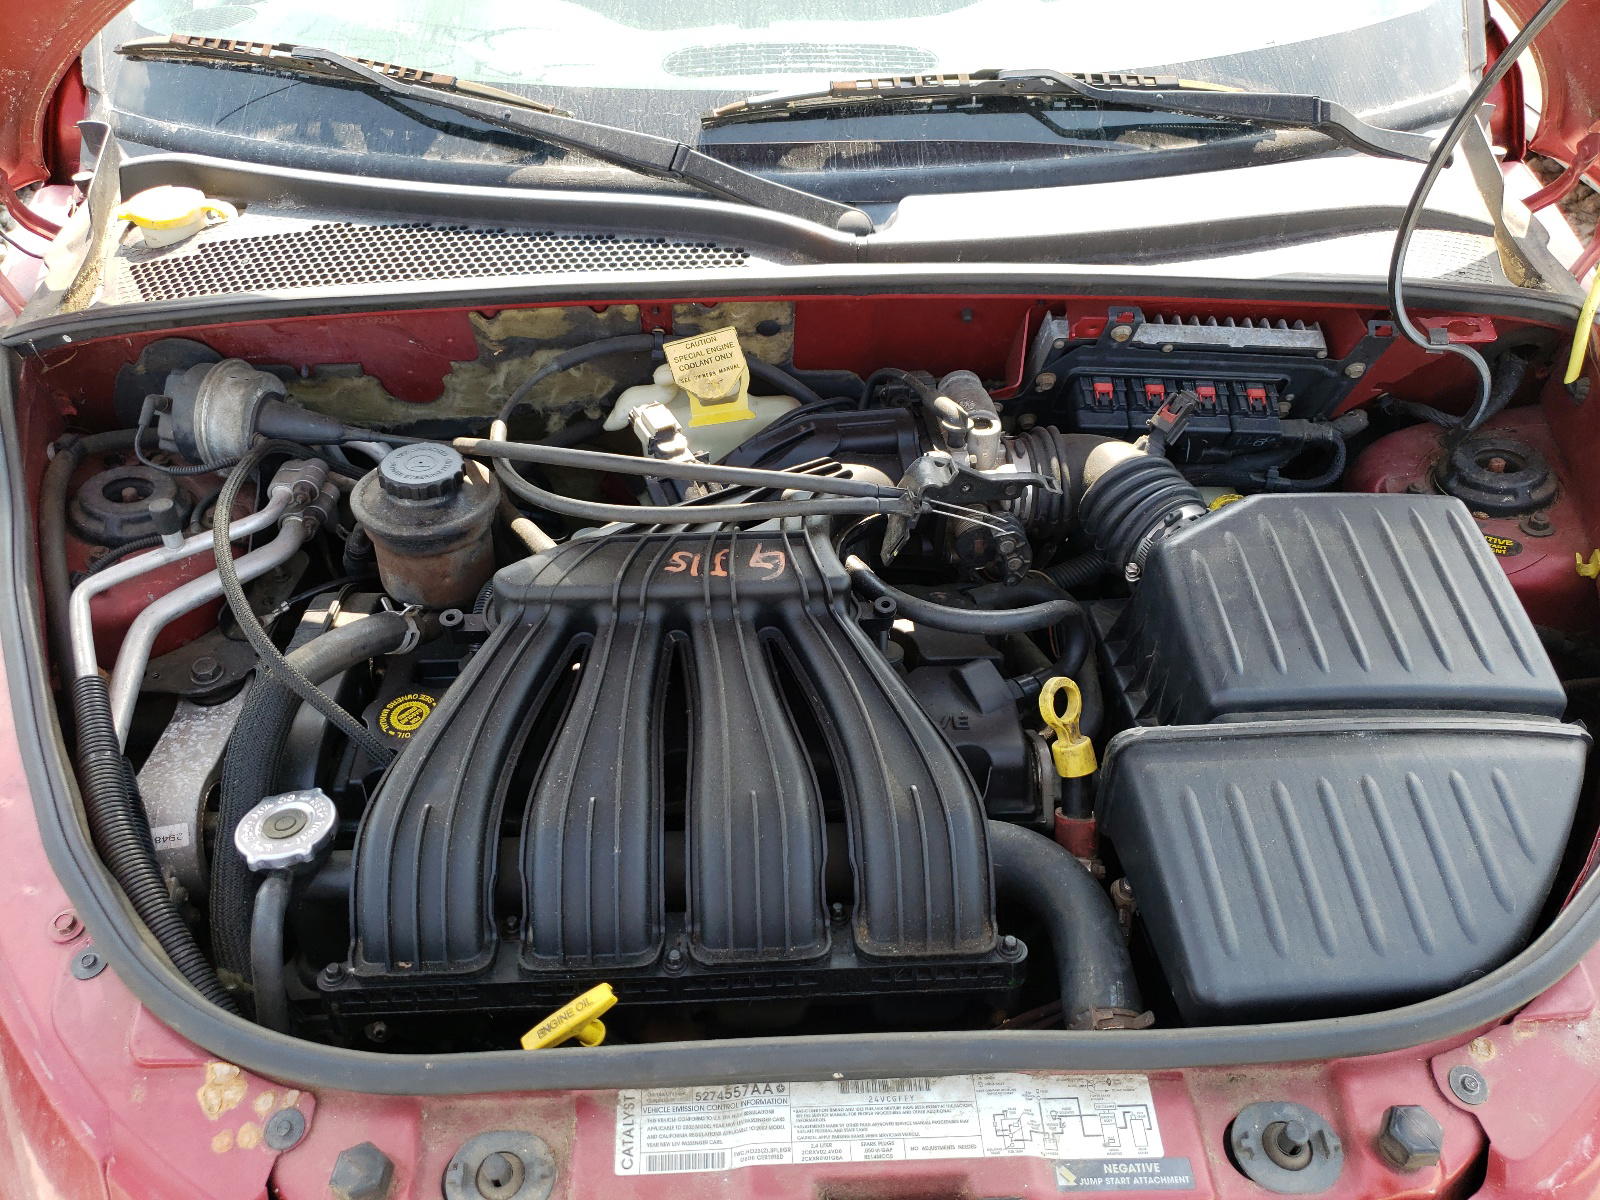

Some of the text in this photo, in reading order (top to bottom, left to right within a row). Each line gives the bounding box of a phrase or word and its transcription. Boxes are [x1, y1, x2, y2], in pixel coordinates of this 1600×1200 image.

[685, 335, 717, 350] CAUTION
[673, 341, 736, 364] SPECIAL ENGINE
[678, 351, 734, 372] COOLANT ONLY
[718, 363, 741, 374] MANUAL
[536, 997, 594, 1039] ENGINE OIL
[695, 1083, 774, 1102] 5274557AA
[643, 1104, 671, 1114] VEHICLE
[672, 1103, 705, 1113] EMISSION
[706, 1101, 740, 1111] CONTROL
[740, 1097, 788, 1109] INFORMATION
[621, 1095, 636, 1171] CATALYST
[1103, 1162, 1161, 1174] NEGATIVE
[1079, 1175, 1190, 1186] JUMP START ATTACHMENT
